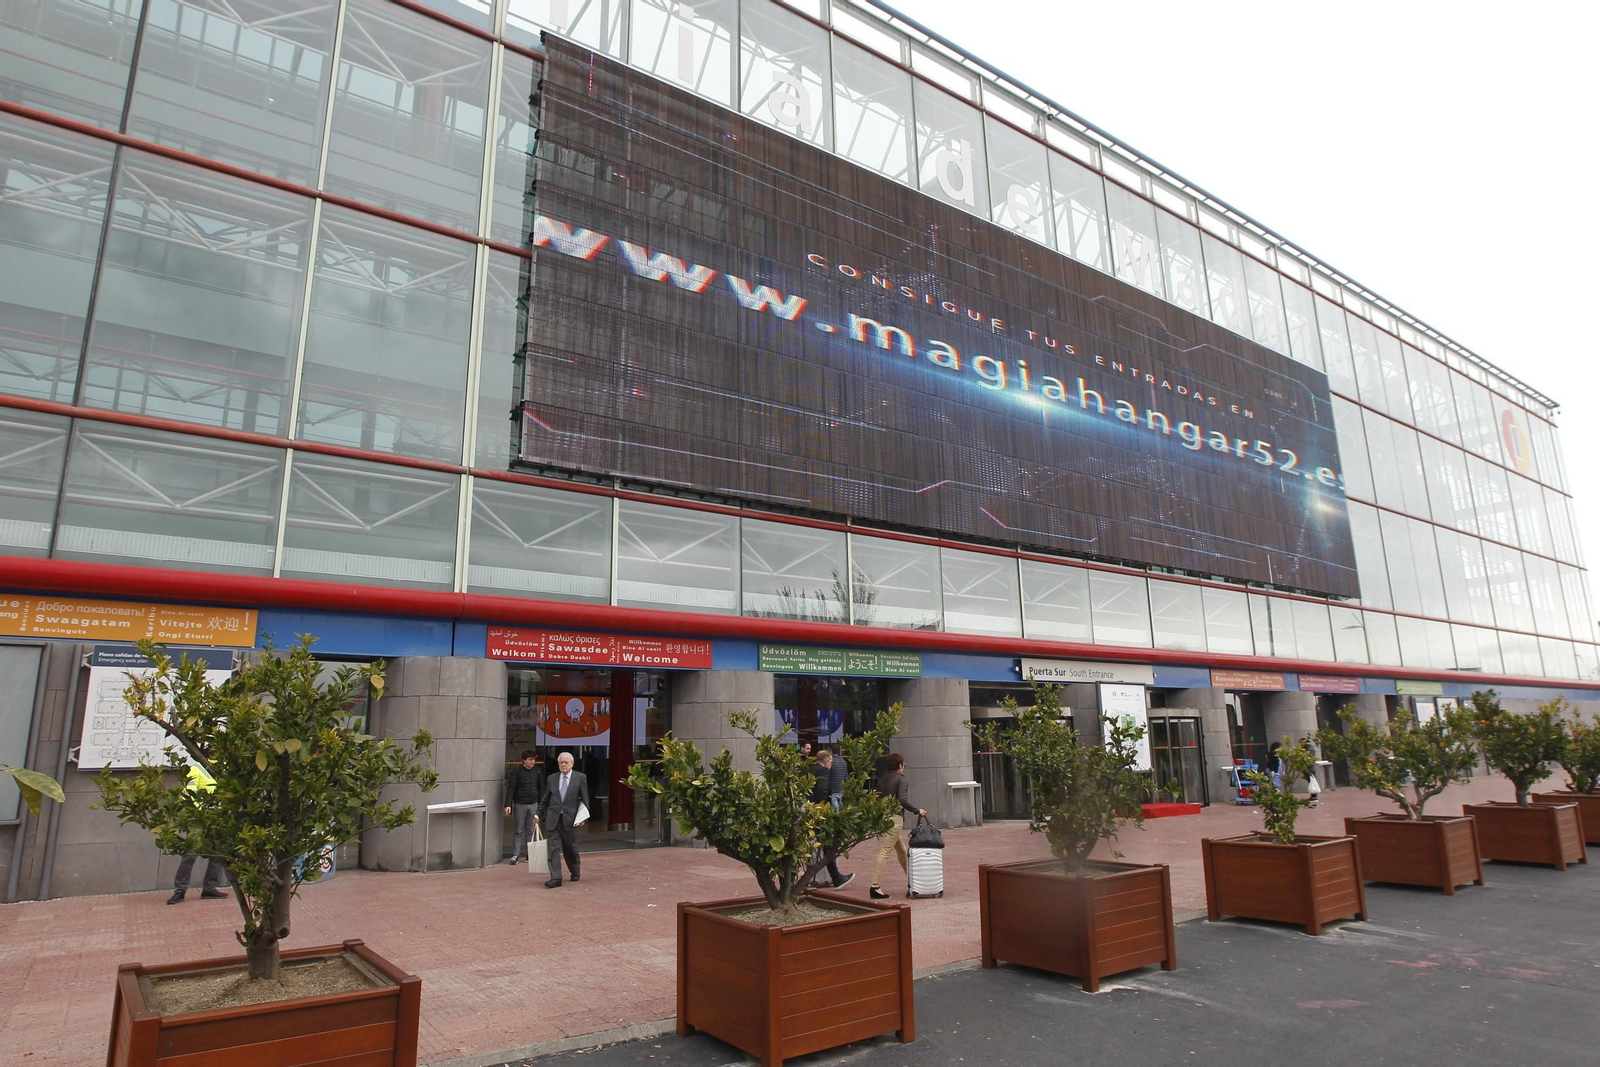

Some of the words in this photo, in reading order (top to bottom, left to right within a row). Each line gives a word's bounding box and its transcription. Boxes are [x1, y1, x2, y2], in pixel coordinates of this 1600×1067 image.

[935, 138, 1040, 236] de
[807, 252, 1004, 333] CONSIGUE
[1026, 329, 1077, 356] TUS
[1095, 354, 1217, 407] ENTRADAS
[1231, 403, 1255, 420] EN
[36, 601, 74, 613] Добро
[76, 605, 145, 616] пожаловать!
[35, 614, 131, 628] Swaagatam
[146, 606, 156, 638] Karibu
[33, 626, 87, 635] Benvinguts
[158, 631, 182, 639] Ongi
[185, 632, 214, 640] Etorri
[549, 633, 575, 644] καλώς
[492, 648, 537, 658] Welkom
[548, 643, 608, 654] Sawasdee
[665, 643, 709, 655] 환영합니다!
[98, 657, 125, 665] Emergency
[622, 653, 678, 664] Welcome
[798, 663, 842, 672] Willkommen
[1028, 666, 1053, 676] Puerta
[1054, 668, 1066, 676] Sur
[1069, 668, 1087, 678] South
[1089, 669, 1115, 679] Entrance
